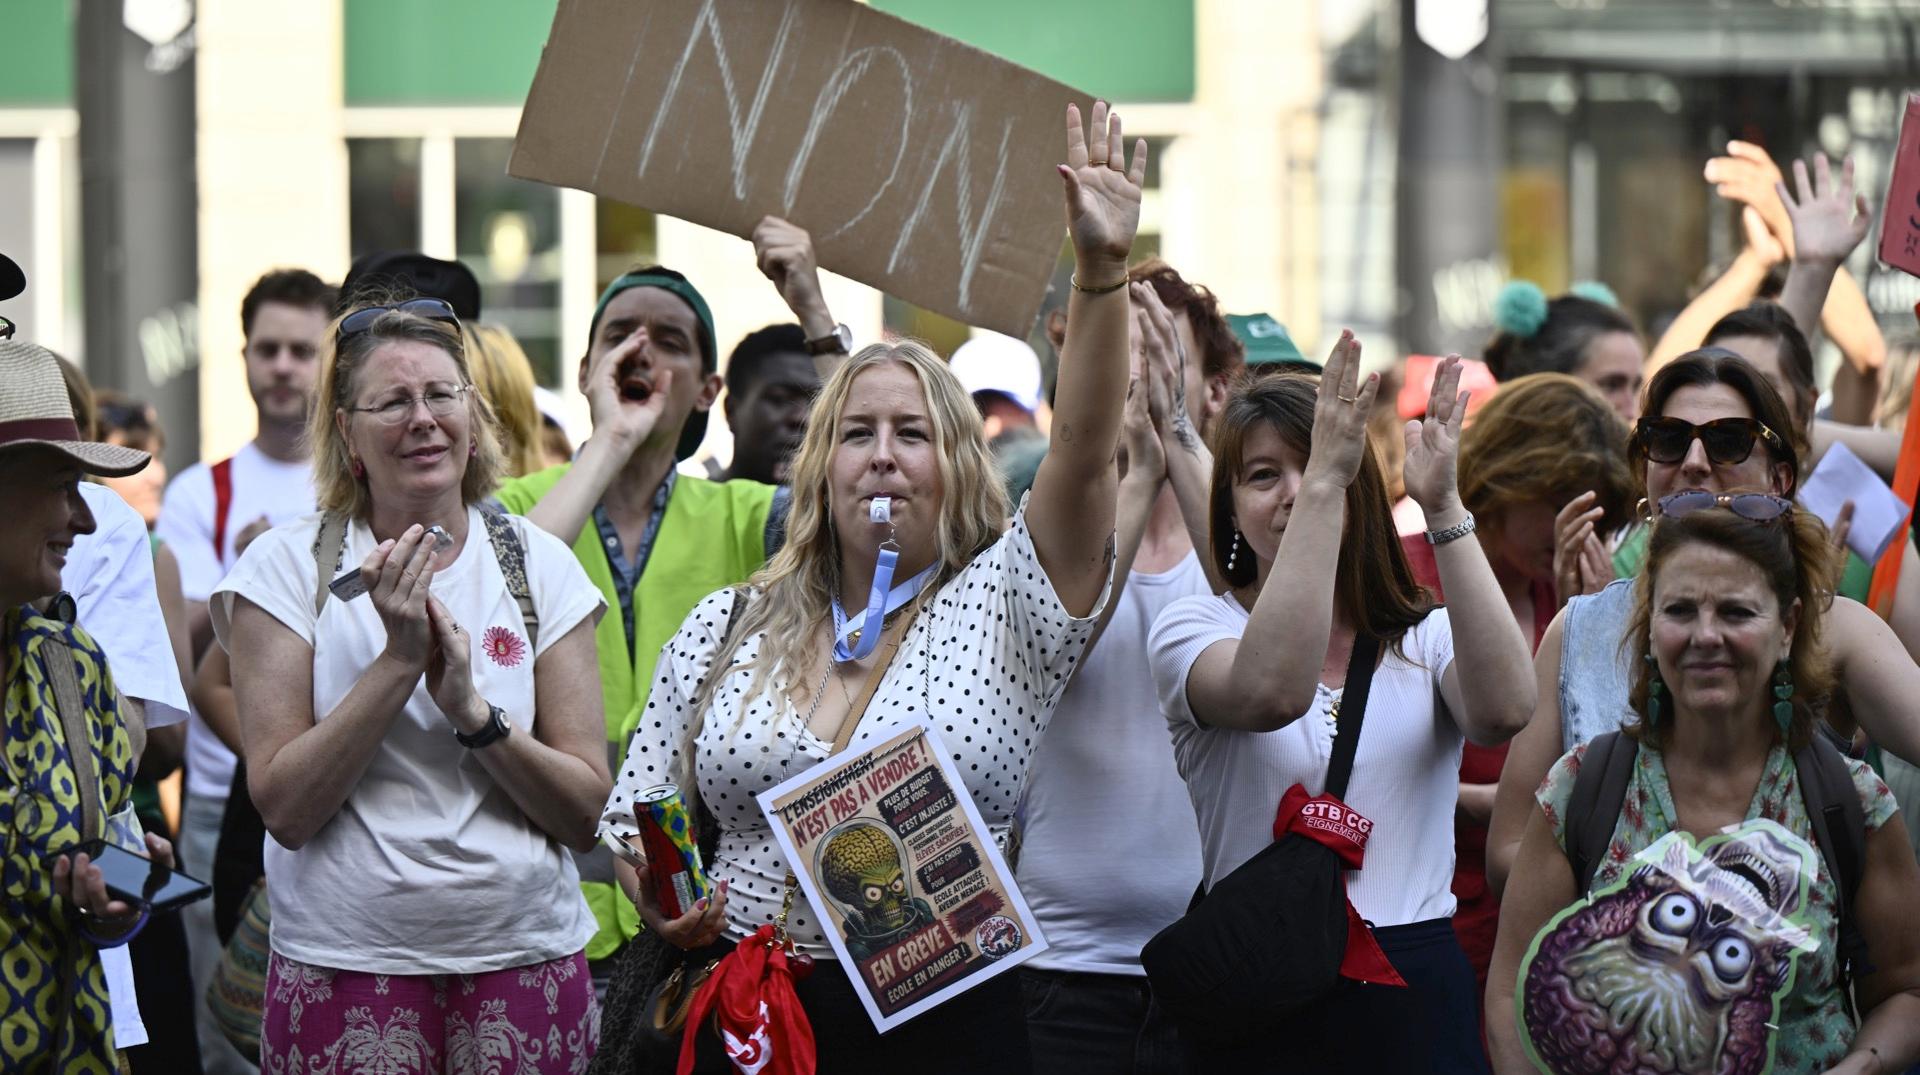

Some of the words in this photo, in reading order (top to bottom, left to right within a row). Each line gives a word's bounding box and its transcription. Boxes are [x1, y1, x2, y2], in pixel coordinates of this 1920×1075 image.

[638, 0, 1013, 313] NON
[784, 752, 874, 824] L'ENSEIGNEMENT
[792, 804, 829, 848] N'EST
[829, 788, 858, 823] PAS
[856, 780, 870, 805] À
[866, 745, 919, 795] VENDRE
[918, 739, 928, 762] !
[884, 792, 900, 808] PLUS
[900, 786, 910, 798] DE
[909, 771, 933, 792] BUDGET
[893, 797, 910, 814] POUR
[899, 815, 918, 834] C'EST
[918, 796, 948, 822] INJUSTE
[947, 793, 953, 804] !
[1301, 803, 1341, 820] GTB
[1346, 813, 1371, 835] CG
[923, 863, 934, 875] J'AI
[934, 857, 944, 869] PAS
[944, 846, 962, 861] CHOISI
[939, 896, 960, 913] AVENIR
[961, 878, 985, 900] MENACÉ
[870, 953, 896, 988] EN
[896, 924, 946, 972] GRÈVE
[887, 978, 915, 1004] ÉCOLE
[914, 970, 928, 987] EN
[927, 949, 962, 979] DANGER
[960, 944, 967, 956] !
